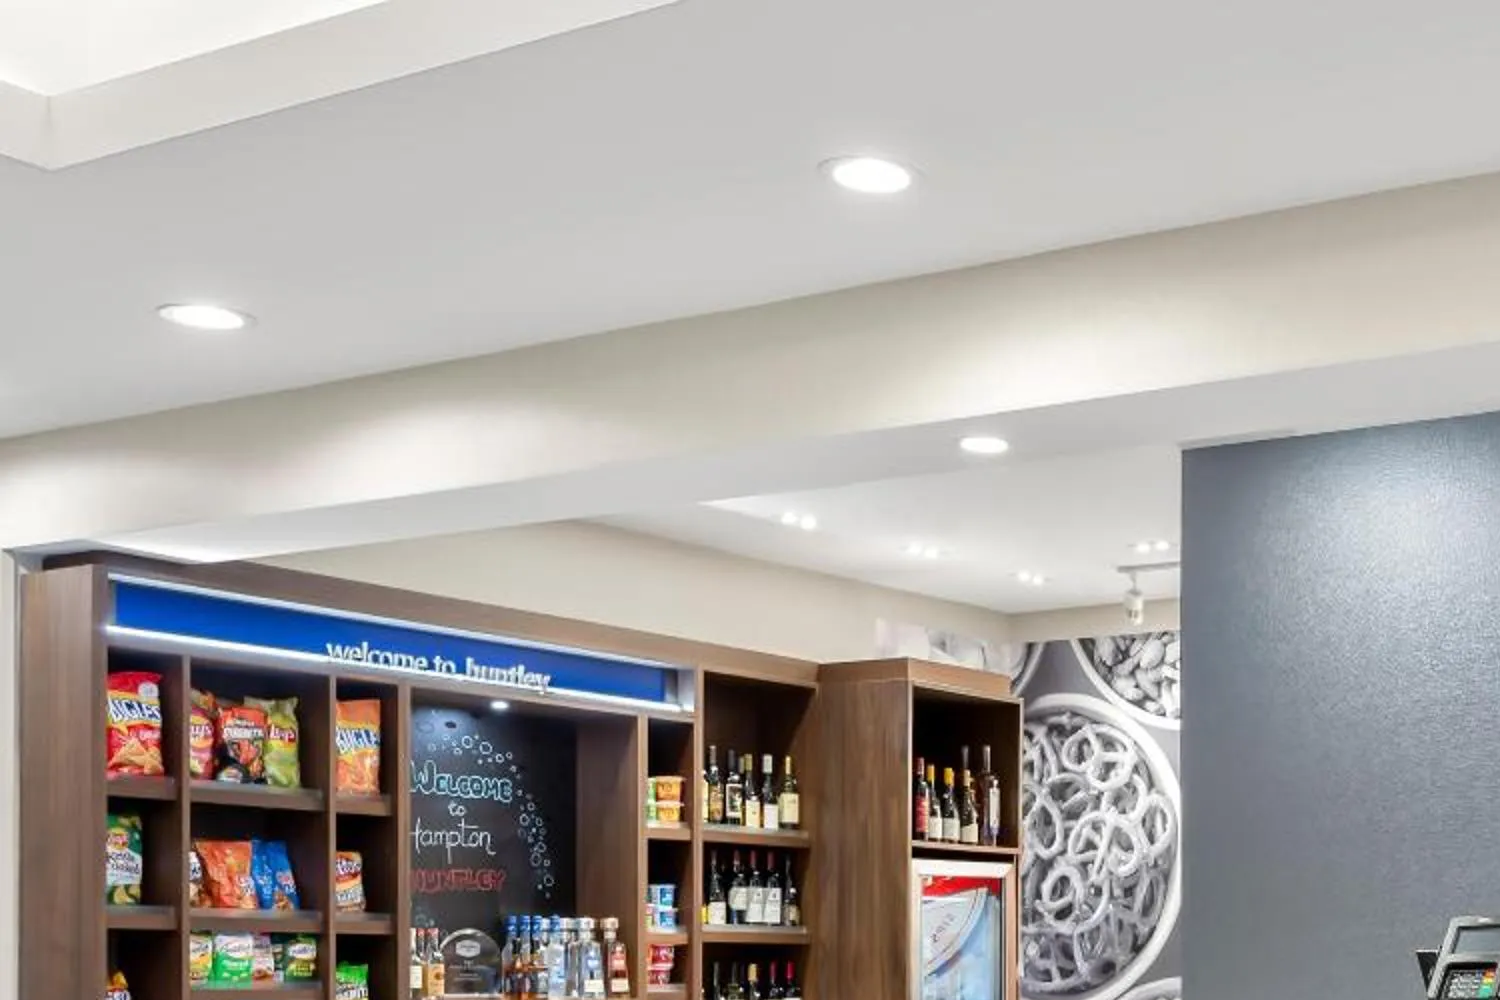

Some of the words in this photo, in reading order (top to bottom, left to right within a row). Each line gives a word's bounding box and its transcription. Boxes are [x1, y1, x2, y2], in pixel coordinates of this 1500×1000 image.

[326, 642, 428, 672] welcome
[432, 655, 457, 676] to
[448, 800, 467, 817] to
